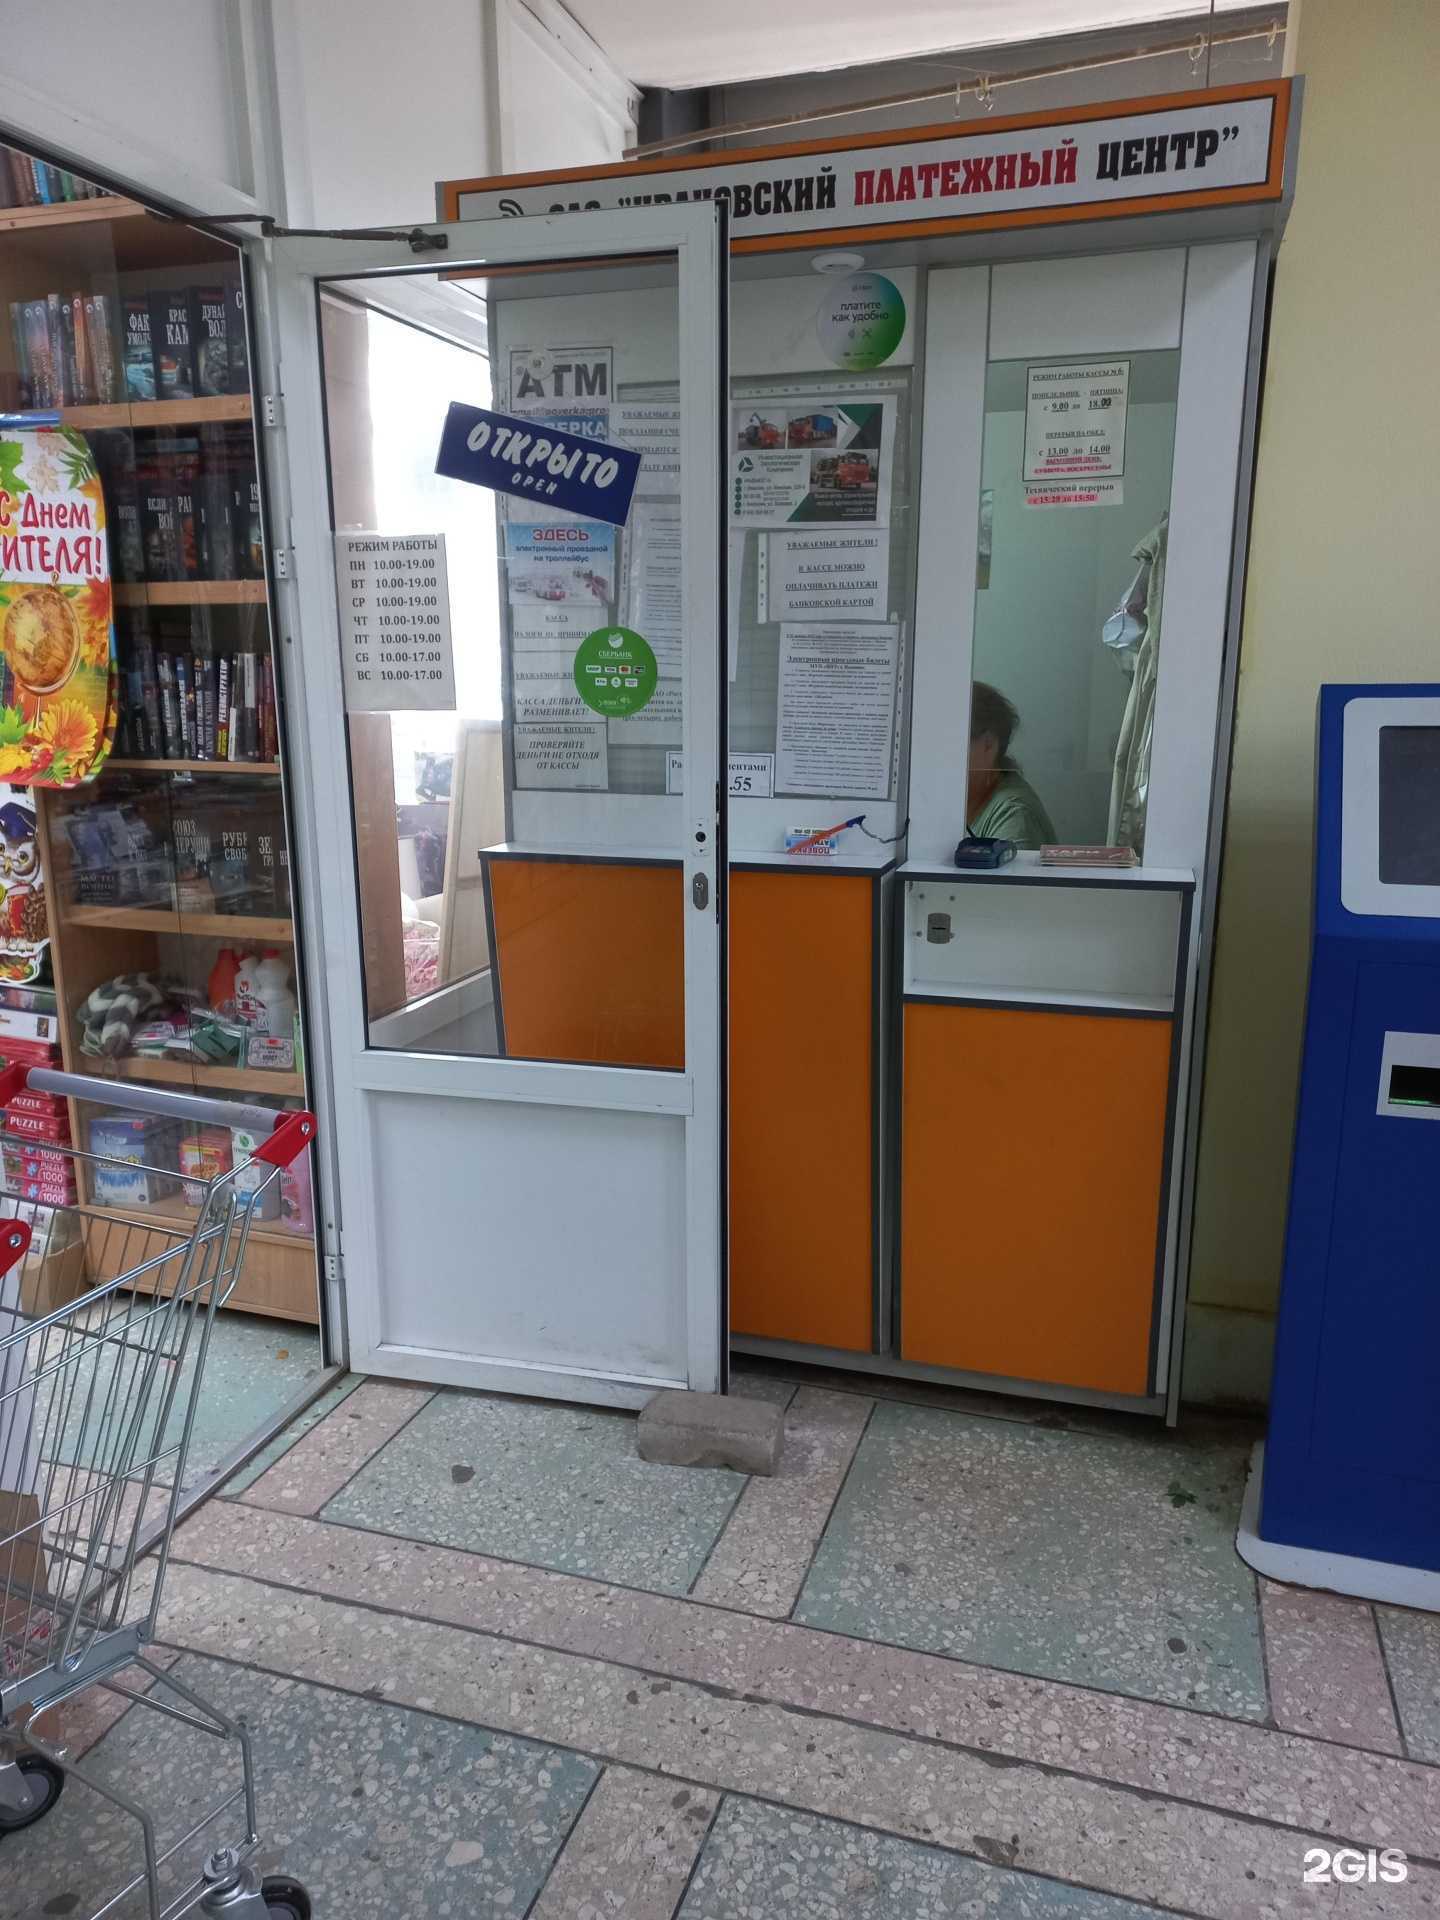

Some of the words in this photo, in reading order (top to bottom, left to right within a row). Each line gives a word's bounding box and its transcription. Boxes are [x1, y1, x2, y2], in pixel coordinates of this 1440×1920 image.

[854, 138, 1079, 206] ПЛАТЕЖНЫЙ
[840, 302, 881, 311] платите
[832, 313, 849, 322] как
[852, 310, 889, 323] удобно
[466, 421, 619, 488] ОТКРЫТО
[1089, 445, 1111, 454] 14.00
[511, 472, 558, 495] OPEN
[1024, 484, 1077, 494] Технический
[1079, 483, 1114, 493] перерыв
[21, 492, 91, 531] Днем
[532, 528, 590, 541] ЗДЕСЬ
[348, 541, 389, 552] РЕЖИМ
[392, 540, 438, 551] РАБОТЫ
[515, 545, 565, 554] электронный
[566, 545, 608, 554] проездной
[2, 535, 102, 575] ИТЕЛЯ!
[545, 554, 589, 563] троллейбус
[350, 561, 366, 571] ПН
[373, 559, 435, 570] 10.00-19.00
[351, 579, 366, 589] ВТ
[375, 577, 437, 589] 10.00-19.00
[352, 598, 366, 608] СР
[375, 596, 437, 607] 10.00-19.00
[354, 616, 368, 626] ЧТ
[378, 614, 440, 626] 10.00-19.00
[354, 634, 370, 644] ПТ
[380, 633, 442, 644] 10.00-19.00
[355, 652, 369, 662] СБ
[380, 651, 441, 662] 10.00-17.00
[598, 650, 632, 658] СБЕРБАНК
[357, 670, 372, 681] ВС
[381, 670, 442, 681] 10.00-17.00
[529, 740, 585, 749] ПРОВЕРЯЙТЕ
[565, 751, 600, 760] ОТХОДЯ
[536, 761, 549, 769] ОТ
[550, 761, 580, 770] КАССЫ
[11, 1096, 41, 1109] PUZZLE
[10, 1116, 45, 1131] PUZZLE
[42, 1171, 64, 1183] 1000
[42, 1192, 64, 1204] 1000
